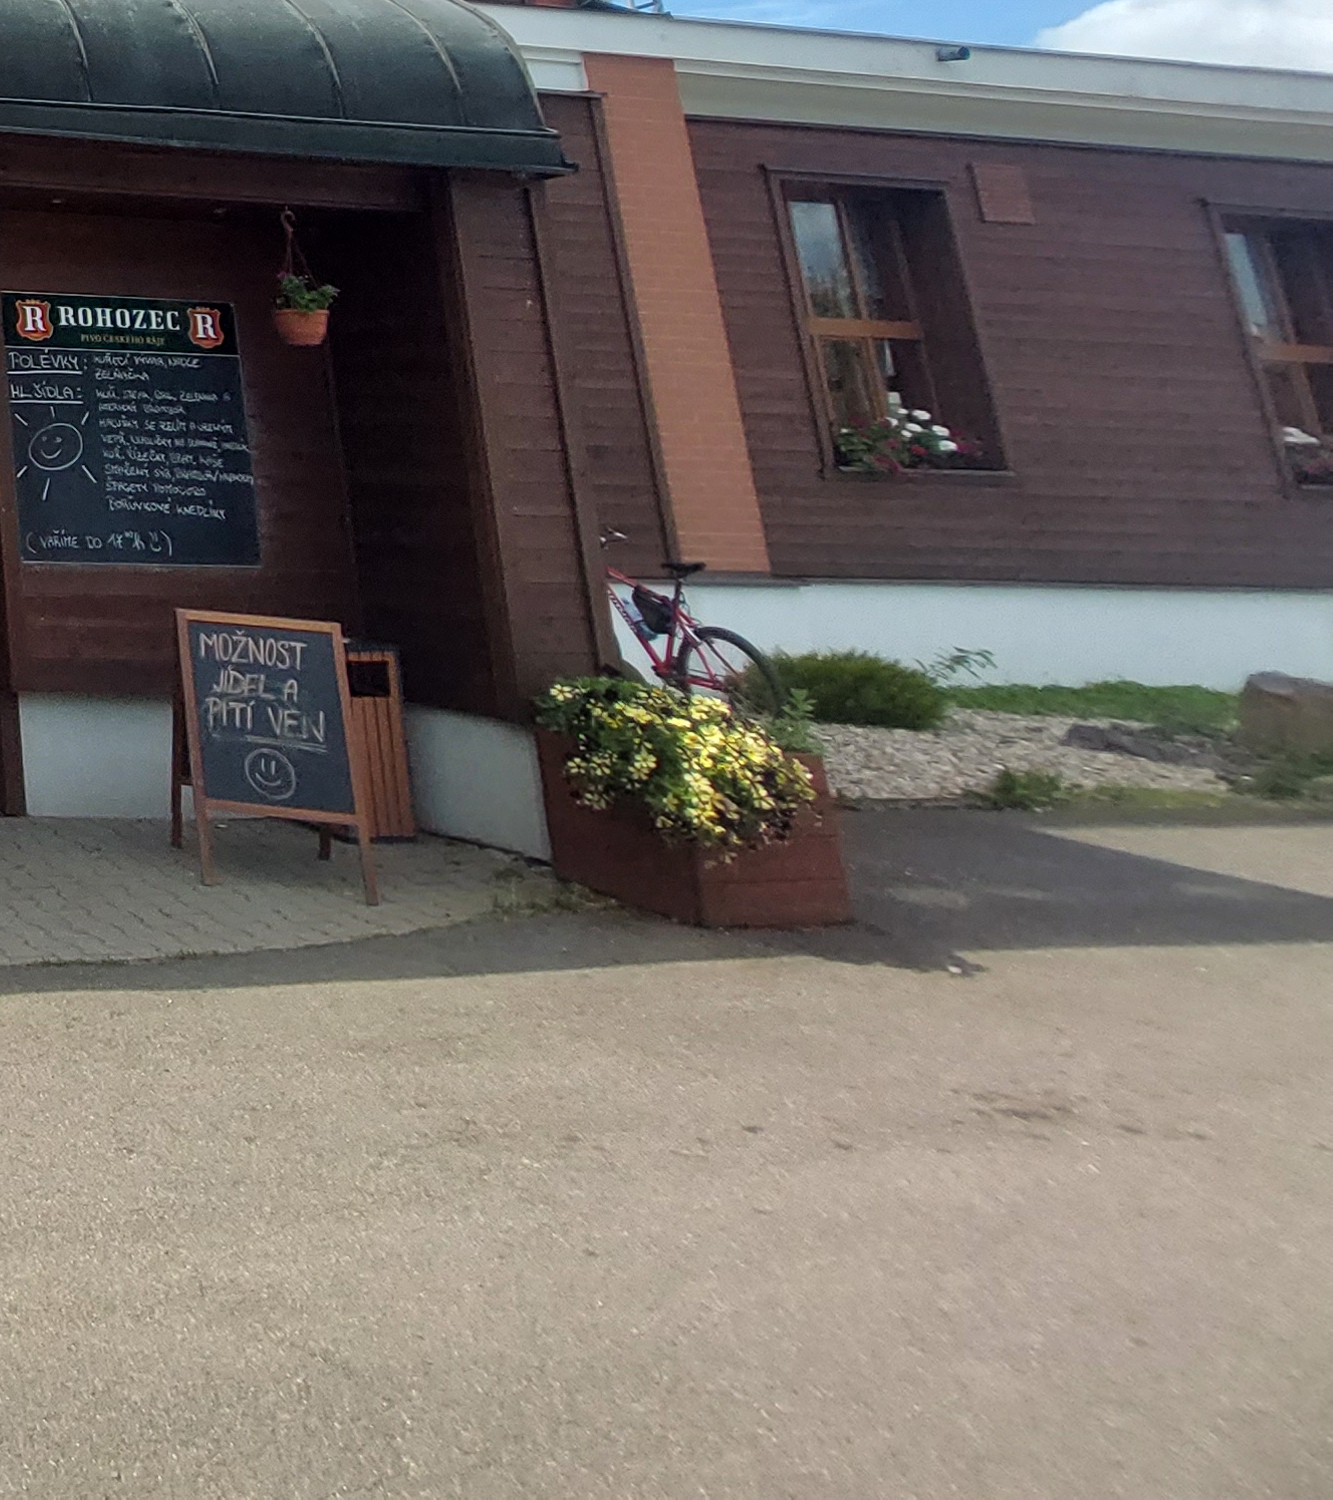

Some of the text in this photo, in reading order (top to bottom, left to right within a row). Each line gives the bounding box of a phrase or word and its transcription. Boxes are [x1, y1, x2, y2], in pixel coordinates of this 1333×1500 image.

[57, 306, 181, 331] ROHOZEC
[199, 630, 308, 670] MOŽNOST
[212, 665, 298, 703] JÍDEL A
[205, 697, 256, 732] PITÍ
